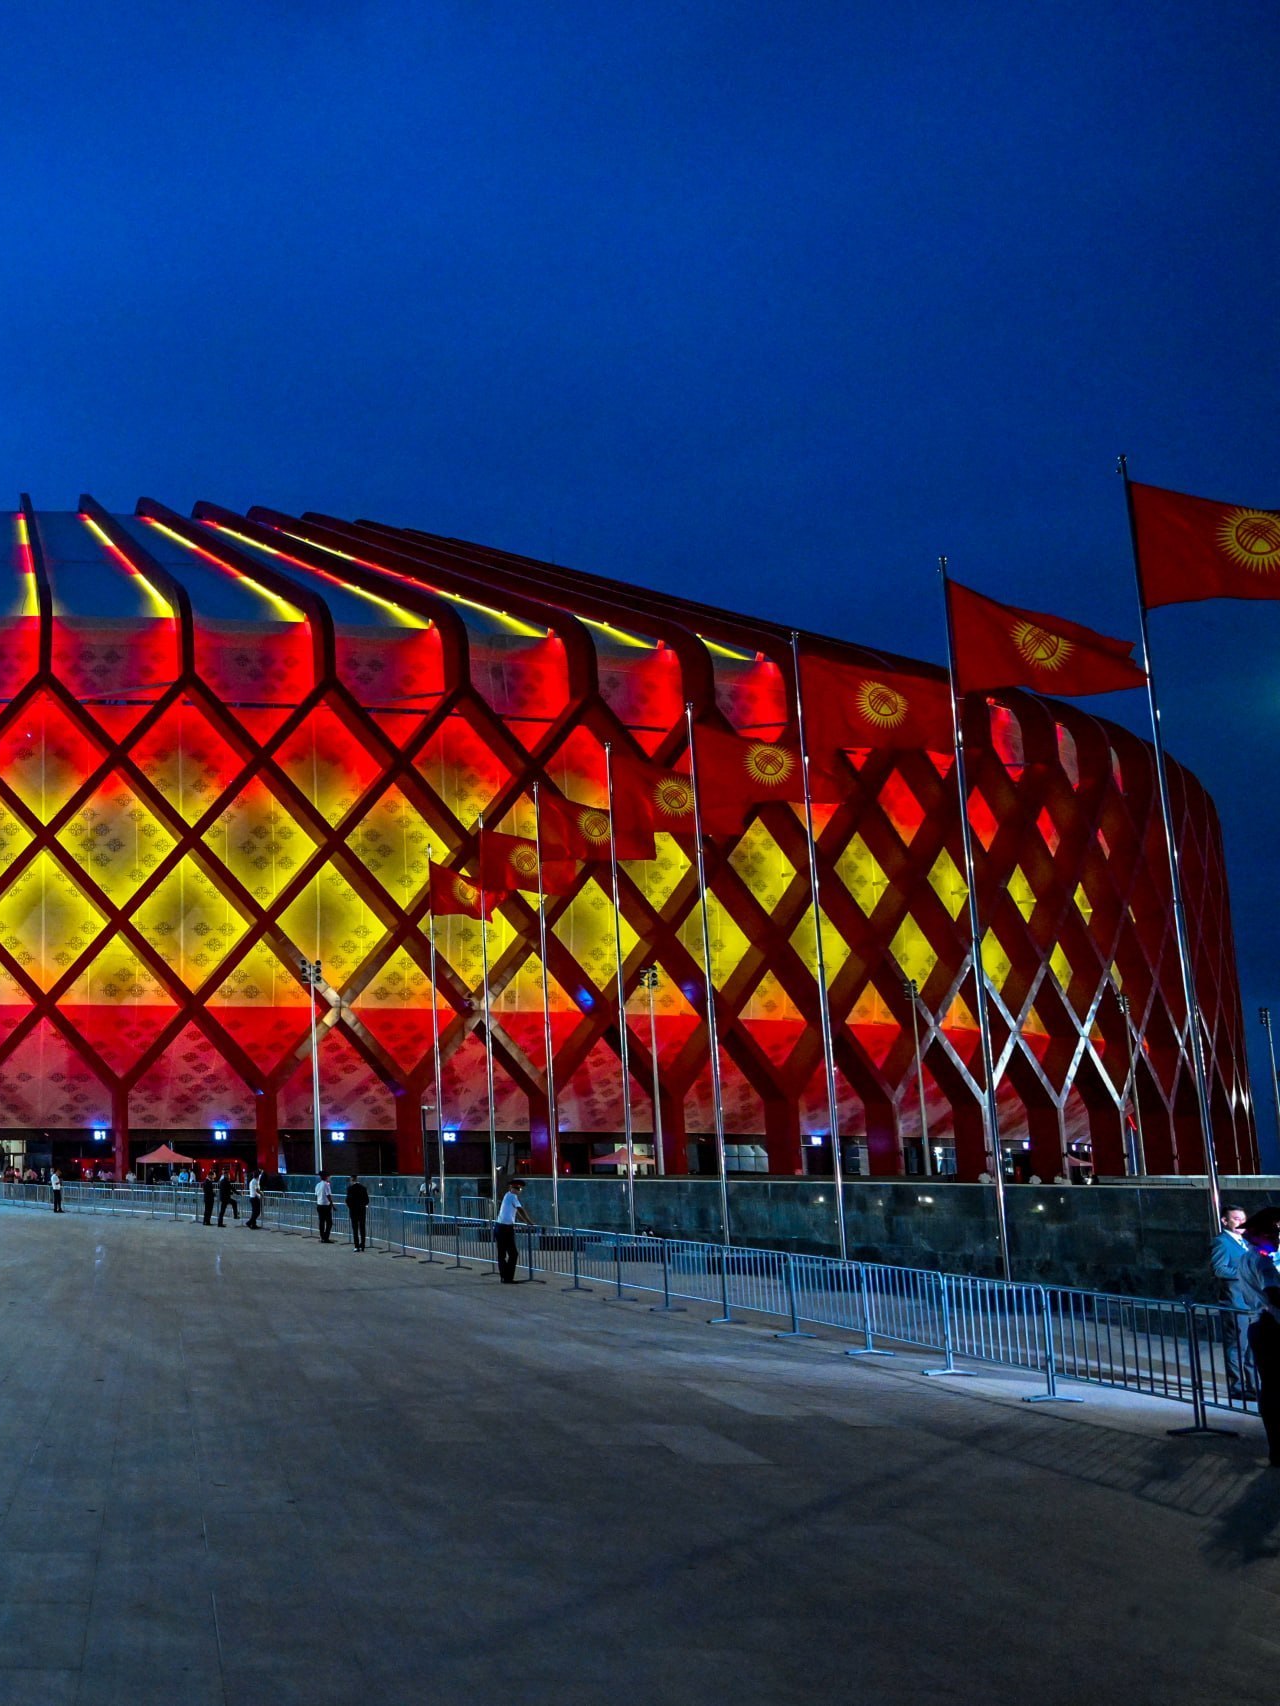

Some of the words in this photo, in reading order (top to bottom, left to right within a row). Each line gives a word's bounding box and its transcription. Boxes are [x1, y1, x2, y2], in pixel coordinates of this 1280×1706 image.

[94, 1130, 106, 1140] B1
[215, 1130, 227, 1140] B1
[331, 1131, 345, 1141] B2
[443, 1132, 456, 1142] B2
